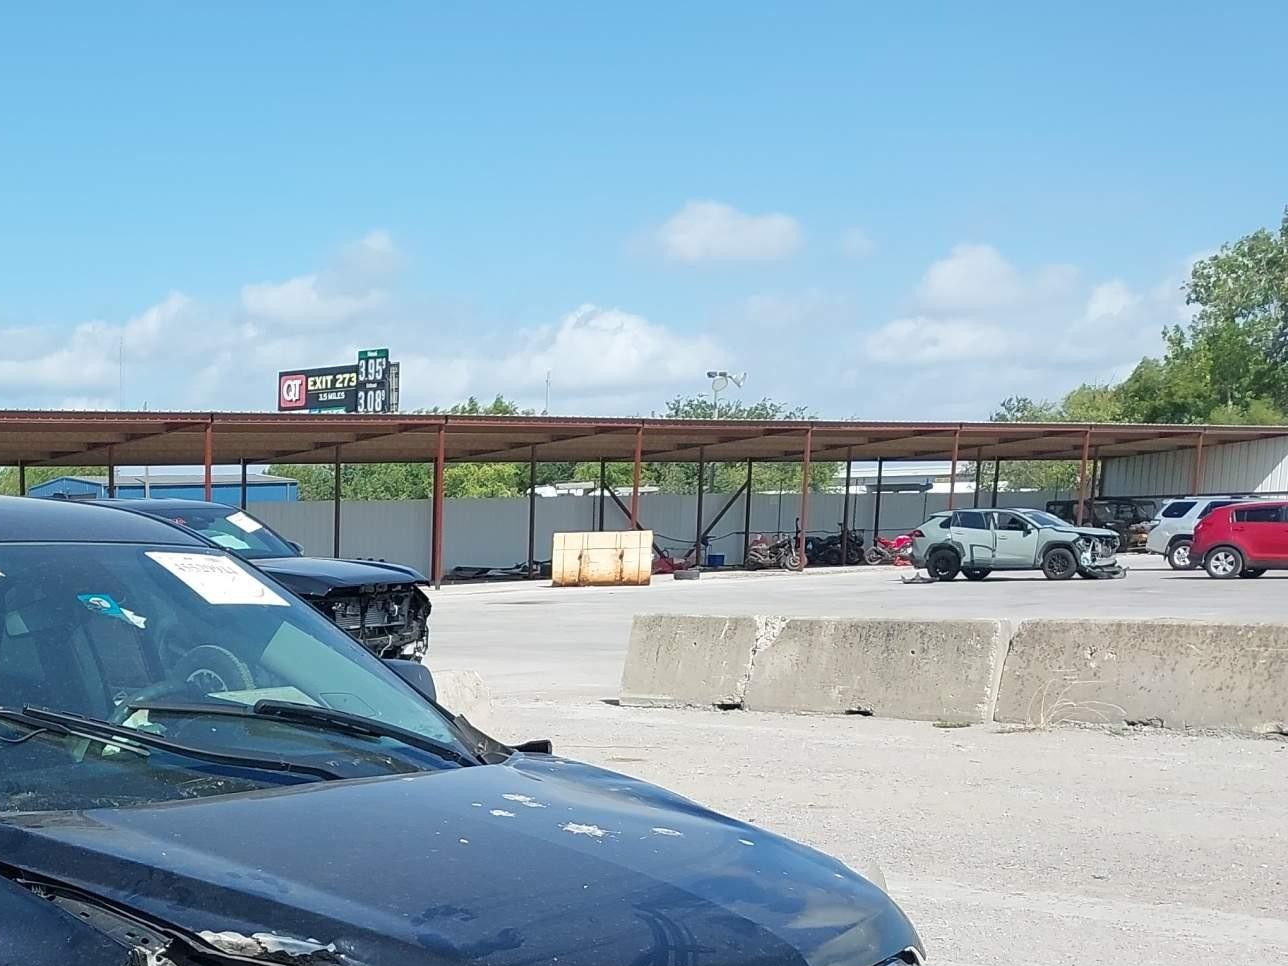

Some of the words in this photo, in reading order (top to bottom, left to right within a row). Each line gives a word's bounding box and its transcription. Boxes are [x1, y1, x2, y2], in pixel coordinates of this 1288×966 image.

[282, 379, 302, 402] QT
[307, 376, 334, 391] EXIT
[335, 372, 357, 388] 273
[327, 392, 346, 400] MILES
